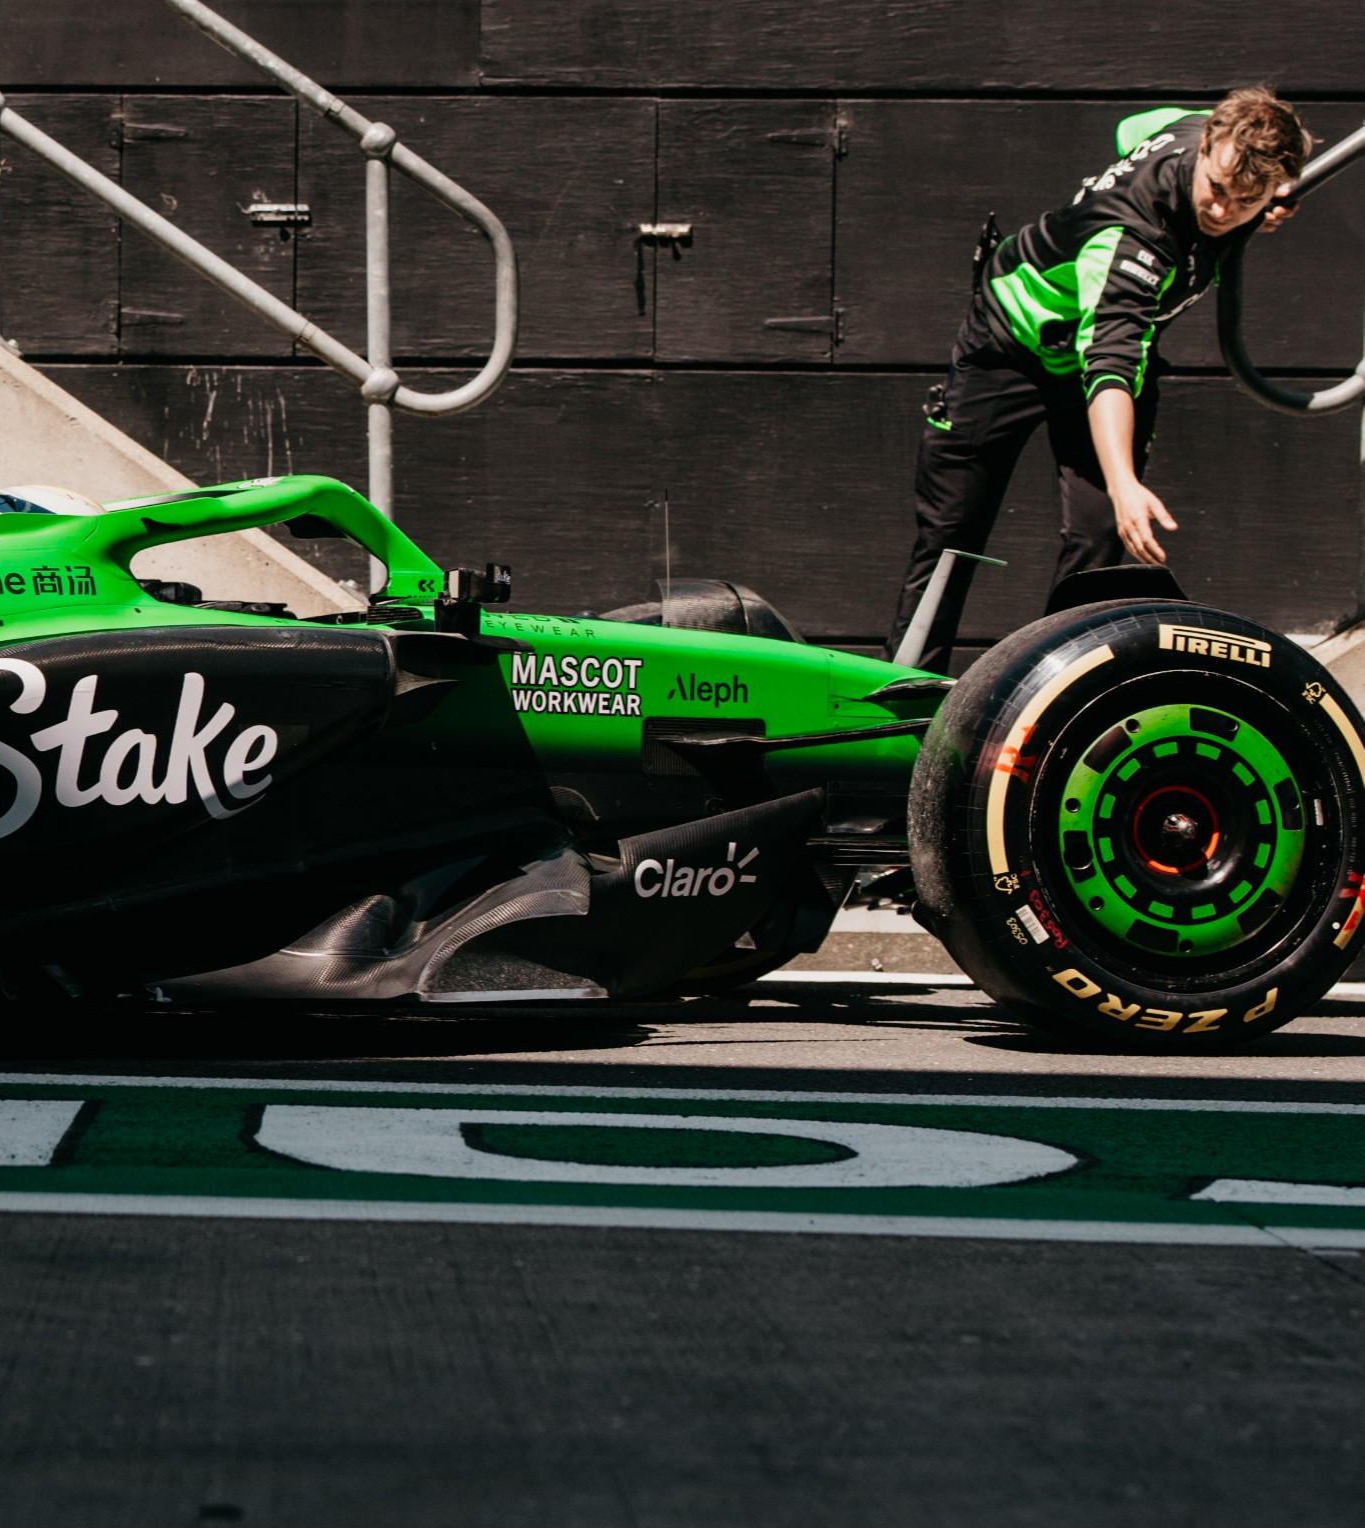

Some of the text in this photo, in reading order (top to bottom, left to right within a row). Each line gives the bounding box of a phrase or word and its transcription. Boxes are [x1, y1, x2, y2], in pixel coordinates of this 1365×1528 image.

[31, 565, 96, 596] 商汤
[485, 620, 596, 638] EYEWEAR
[1158, 624, 1271, 668] PIRELLI
[513, 653, 642, 689] MASCOT
[513, 690, 641, 716] WORKWEAR
[668, 673, 748, 708] Aleph
[635, 859, 735, 898] Claro
[1052, 968, 1279, 1034] P ZERO
